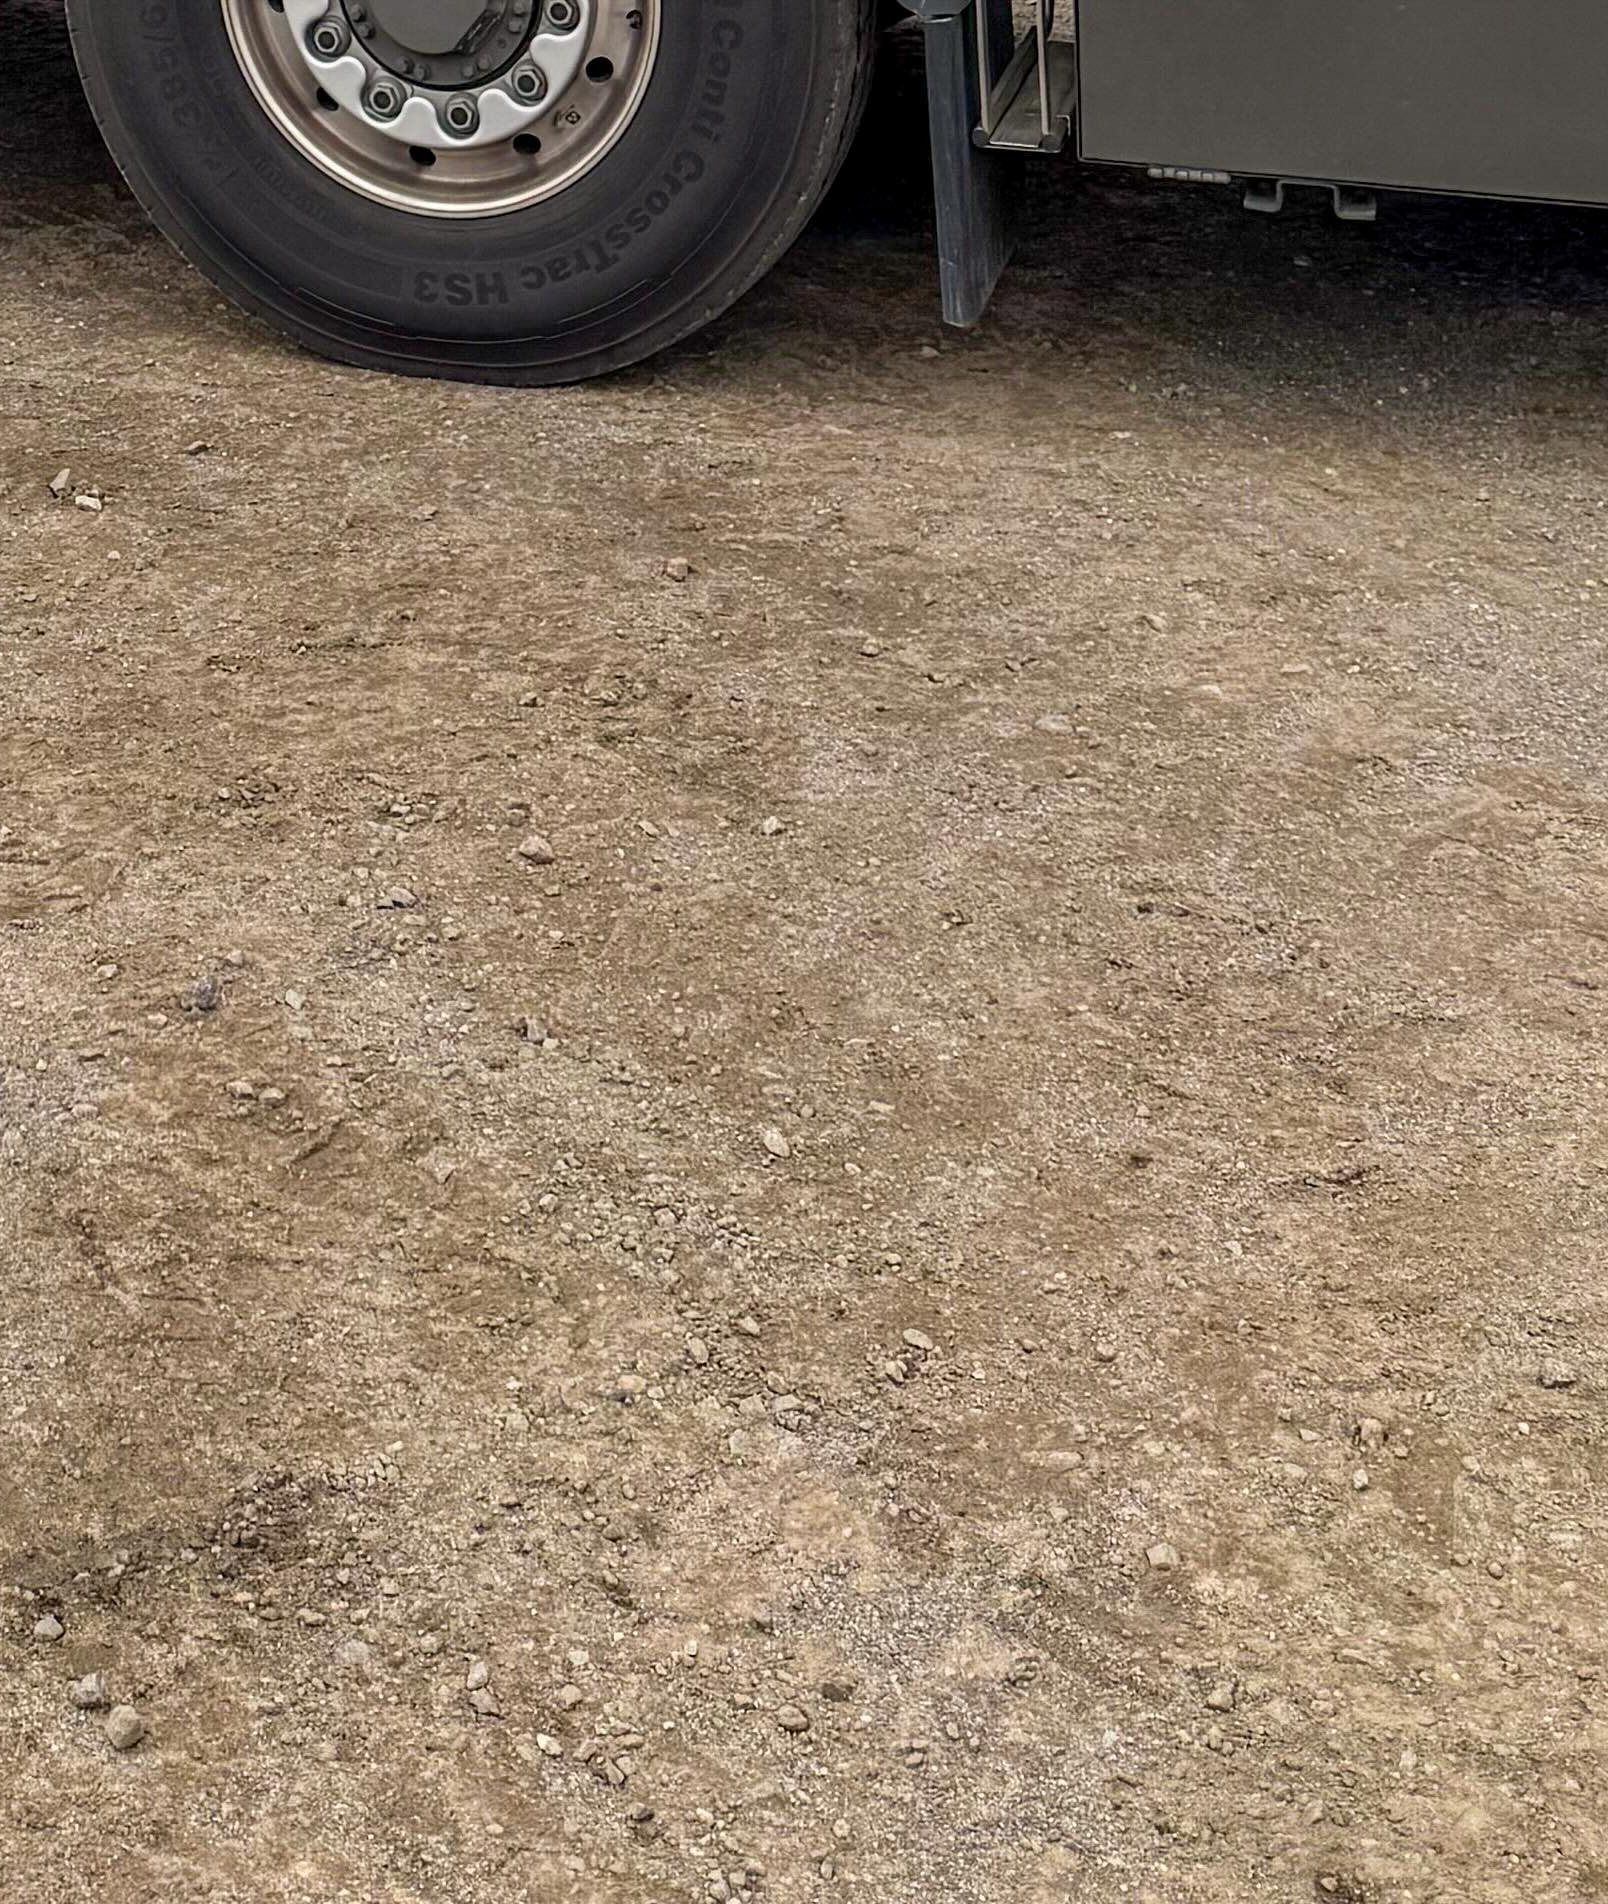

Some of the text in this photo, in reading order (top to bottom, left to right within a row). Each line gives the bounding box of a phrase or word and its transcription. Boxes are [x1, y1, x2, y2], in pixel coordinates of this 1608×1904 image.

[412, 17, 743, 307] Conti CrossTrac HS3
